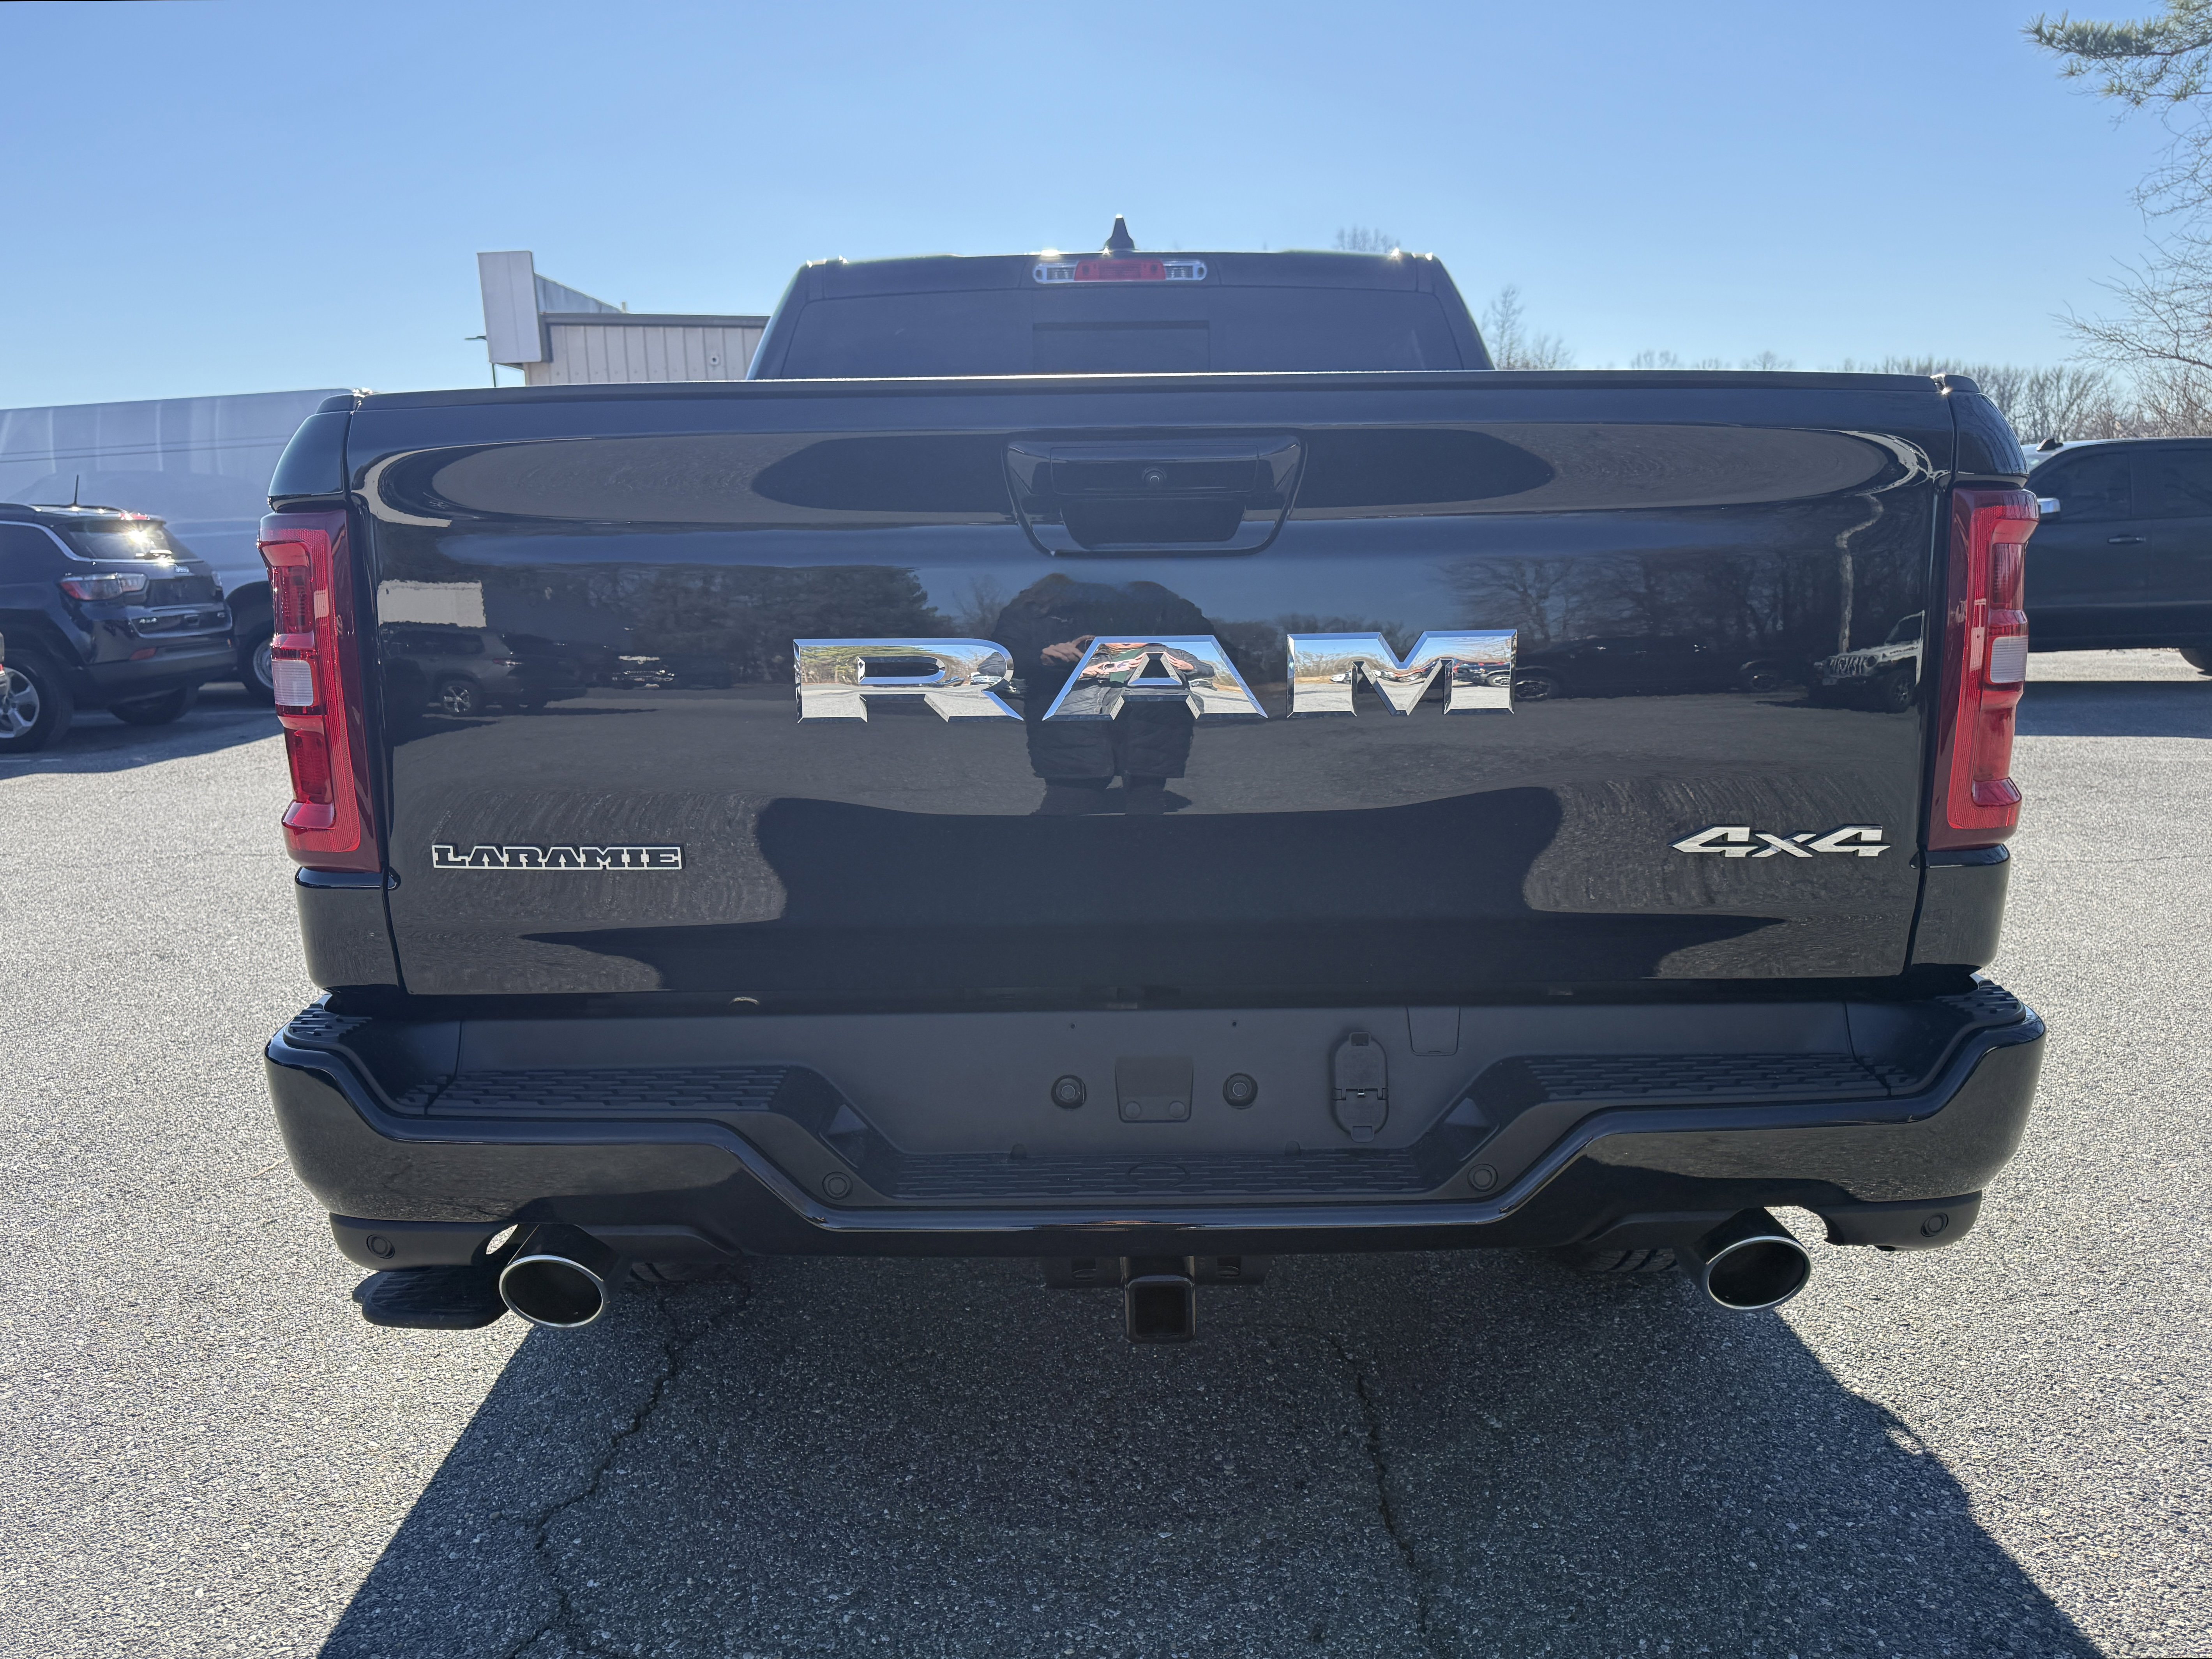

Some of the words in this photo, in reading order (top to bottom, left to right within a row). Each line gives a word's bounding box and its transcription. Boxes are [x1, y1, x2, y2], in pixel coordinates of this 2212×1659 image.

[793, 629, 1517, 724] RAM
[1668, 824, 1891, 857] 4x4
[432, 845, 682, 870] LARAMIE
